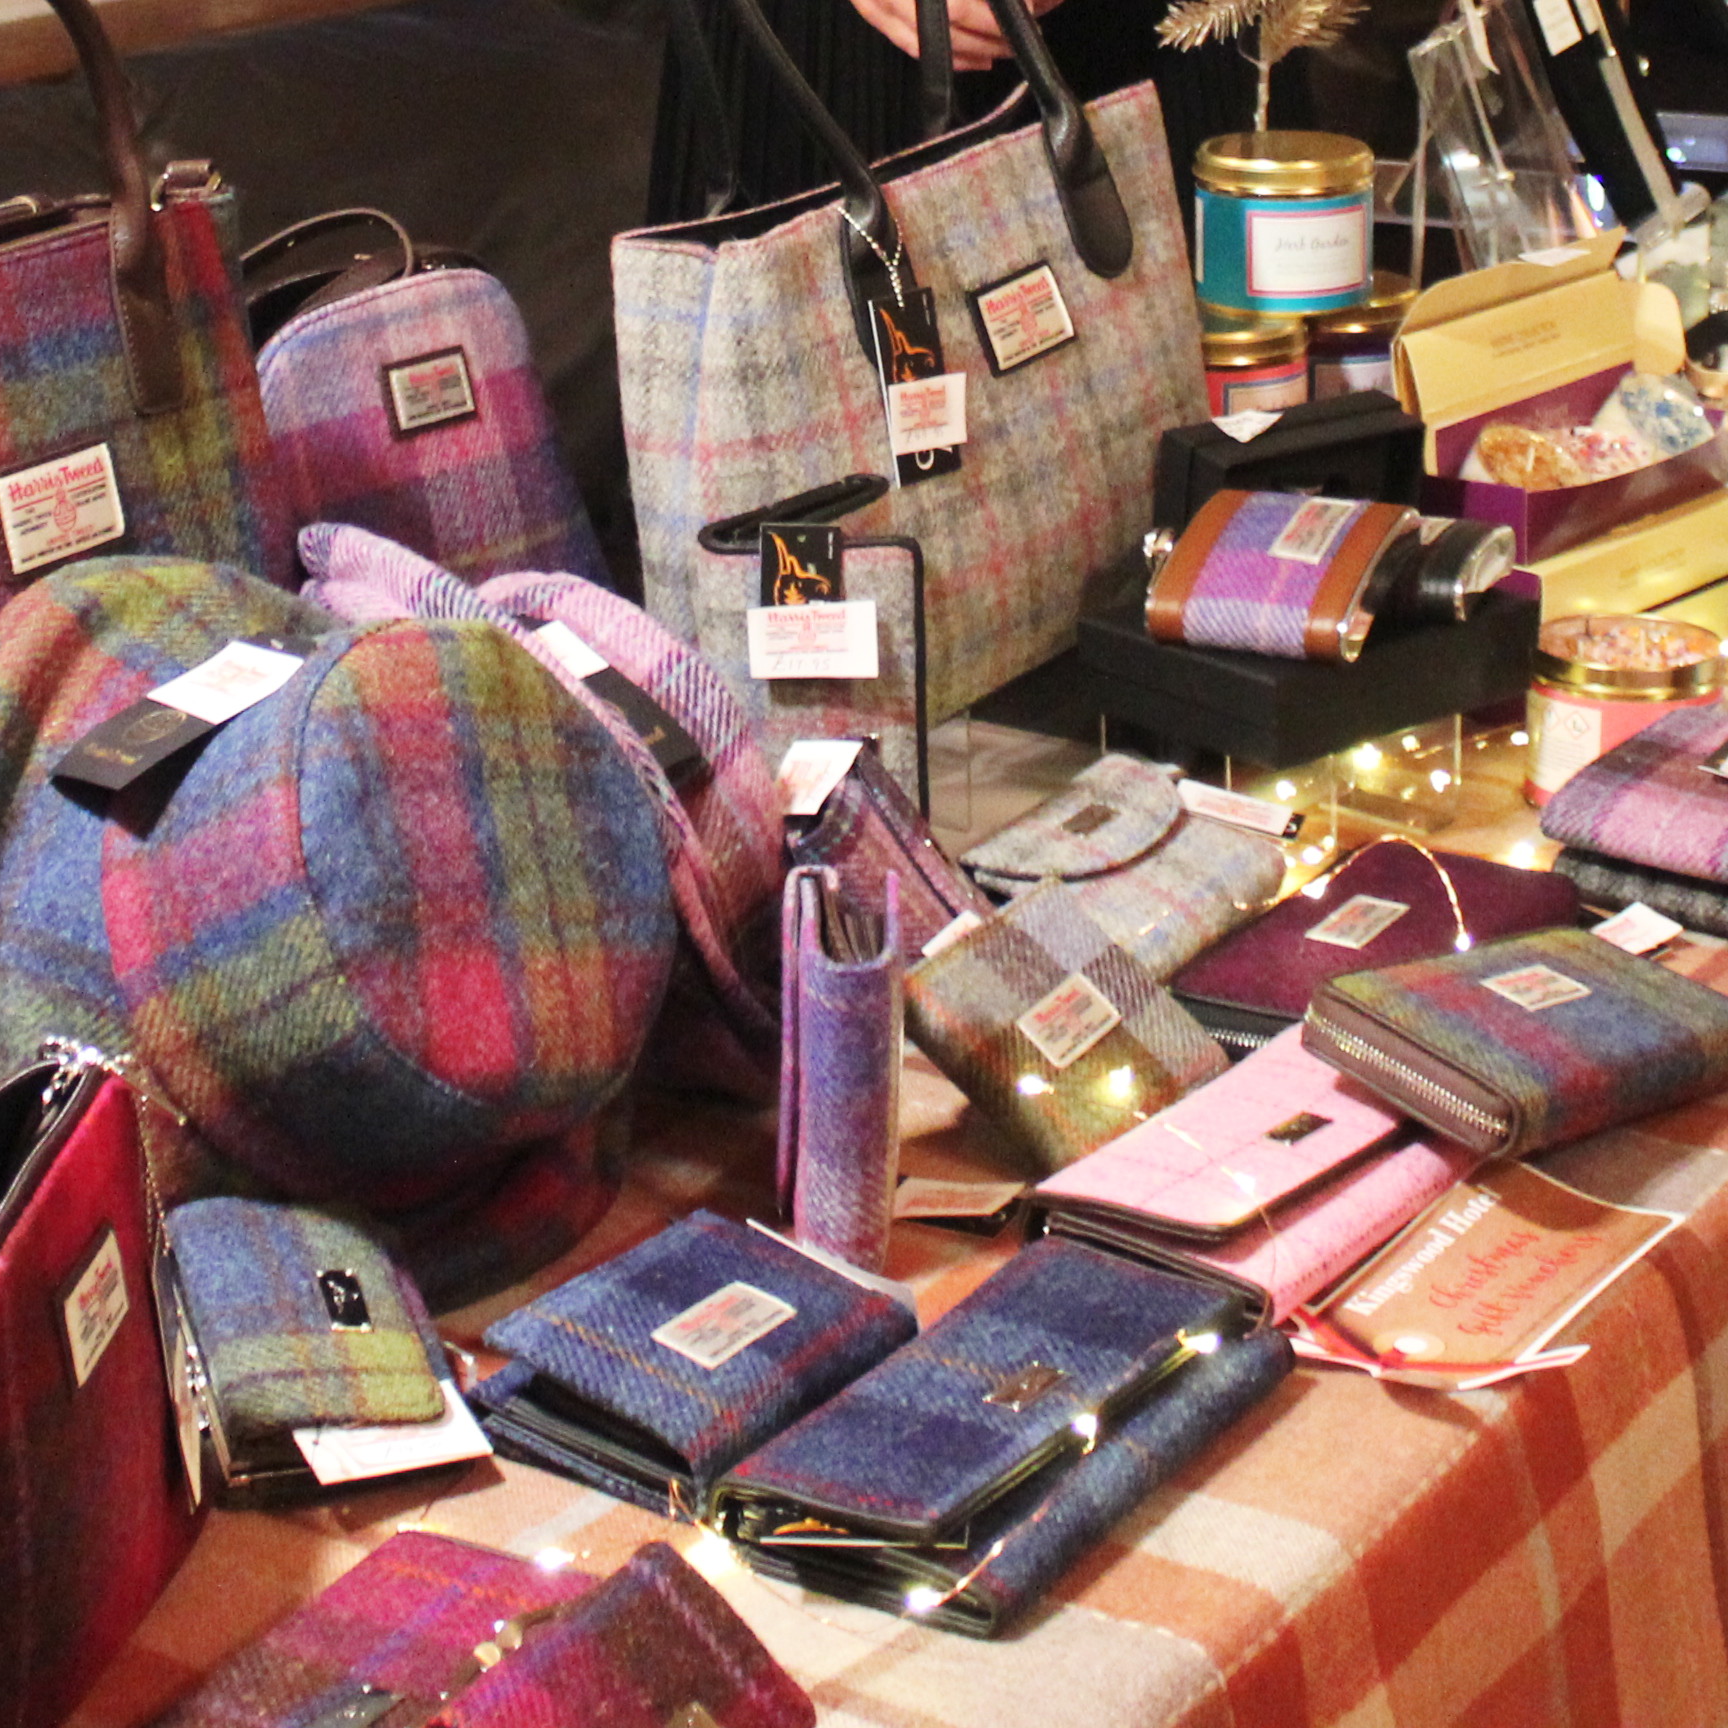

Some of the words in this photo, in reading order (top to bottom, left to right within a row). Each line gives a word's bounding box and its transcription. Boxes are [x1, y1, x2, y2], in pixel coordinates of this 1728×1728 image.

[8, 473, 63, 503] Harris
[58, 457, 104, 484] Tweed
[768, 611, 810, 622] Harris
[811, 608, 846, 620] Tweed
[1343, 1228, 1456, 1317] Kingswood
[1439, 1185, 1502, 1234] Hotel
[1429, 1229, 1541, 1310] Christmas
